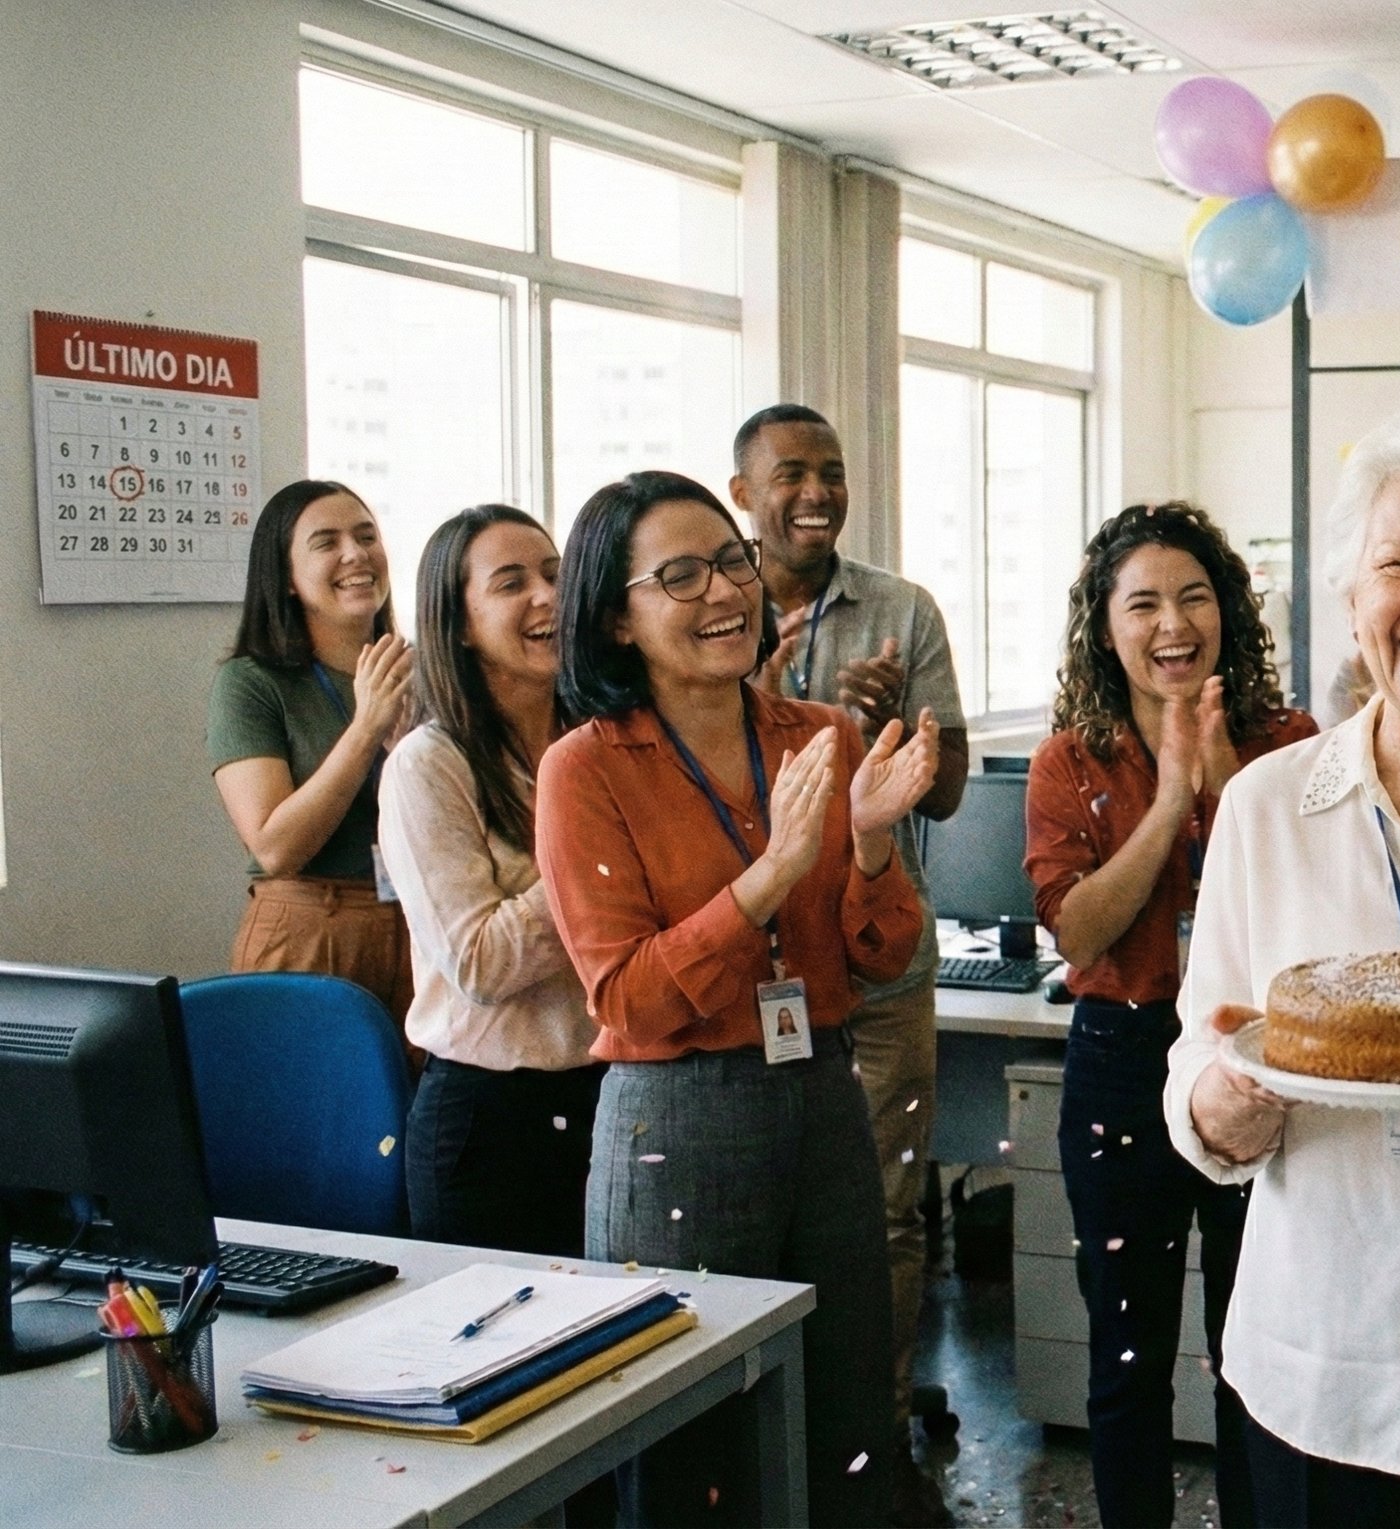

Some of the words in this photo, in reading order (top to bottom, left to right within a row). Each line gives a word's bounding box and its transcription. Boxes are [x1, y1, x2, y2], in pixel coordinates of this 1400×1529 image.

[64, 331, 177, 381] ÚLTIMO
[186, 354, 233, 388] DIA
[119, 416, 128, 430] 1
[148, 419, 158, 433] 2
[178, 422, 187, 435] 3
[205, 424, 214, 437] 4
[232, 426, 242, 440] 5
[60, 442, 70, 458] 6
[90, 444, 100, 459] 7
[120, 447, 130, 461] 8
[149, 448, 159, 463] 9
[176, 451, 192, 465] 10
[202, 452, 218, 467] 11
[231, 454, 247, 468] 12
[58, 474, 76, 489] 13
[88, 476, 106, 490] 14
[119, 477, 136, 492] 15
[148, 478, 166, 493] 16
[176, 480, 192, 494] 17
[231, 483, 248, 497] 19
[58, 504, 78, 520] 20
[88, 506, 106, 521] 21
[118, 508, 137, 522] 22
[148, 509, 166, 522] 23
[176, 510, 193, 524] 24
[231, 512, 248, 526] 26
[60, 536, 78, 551] 27
[90, 536, 109, 552] 28
[120, 537, 138, 552] 29
[149, 538, 167, 552] 30
[177, 539, 194, 552] 31
